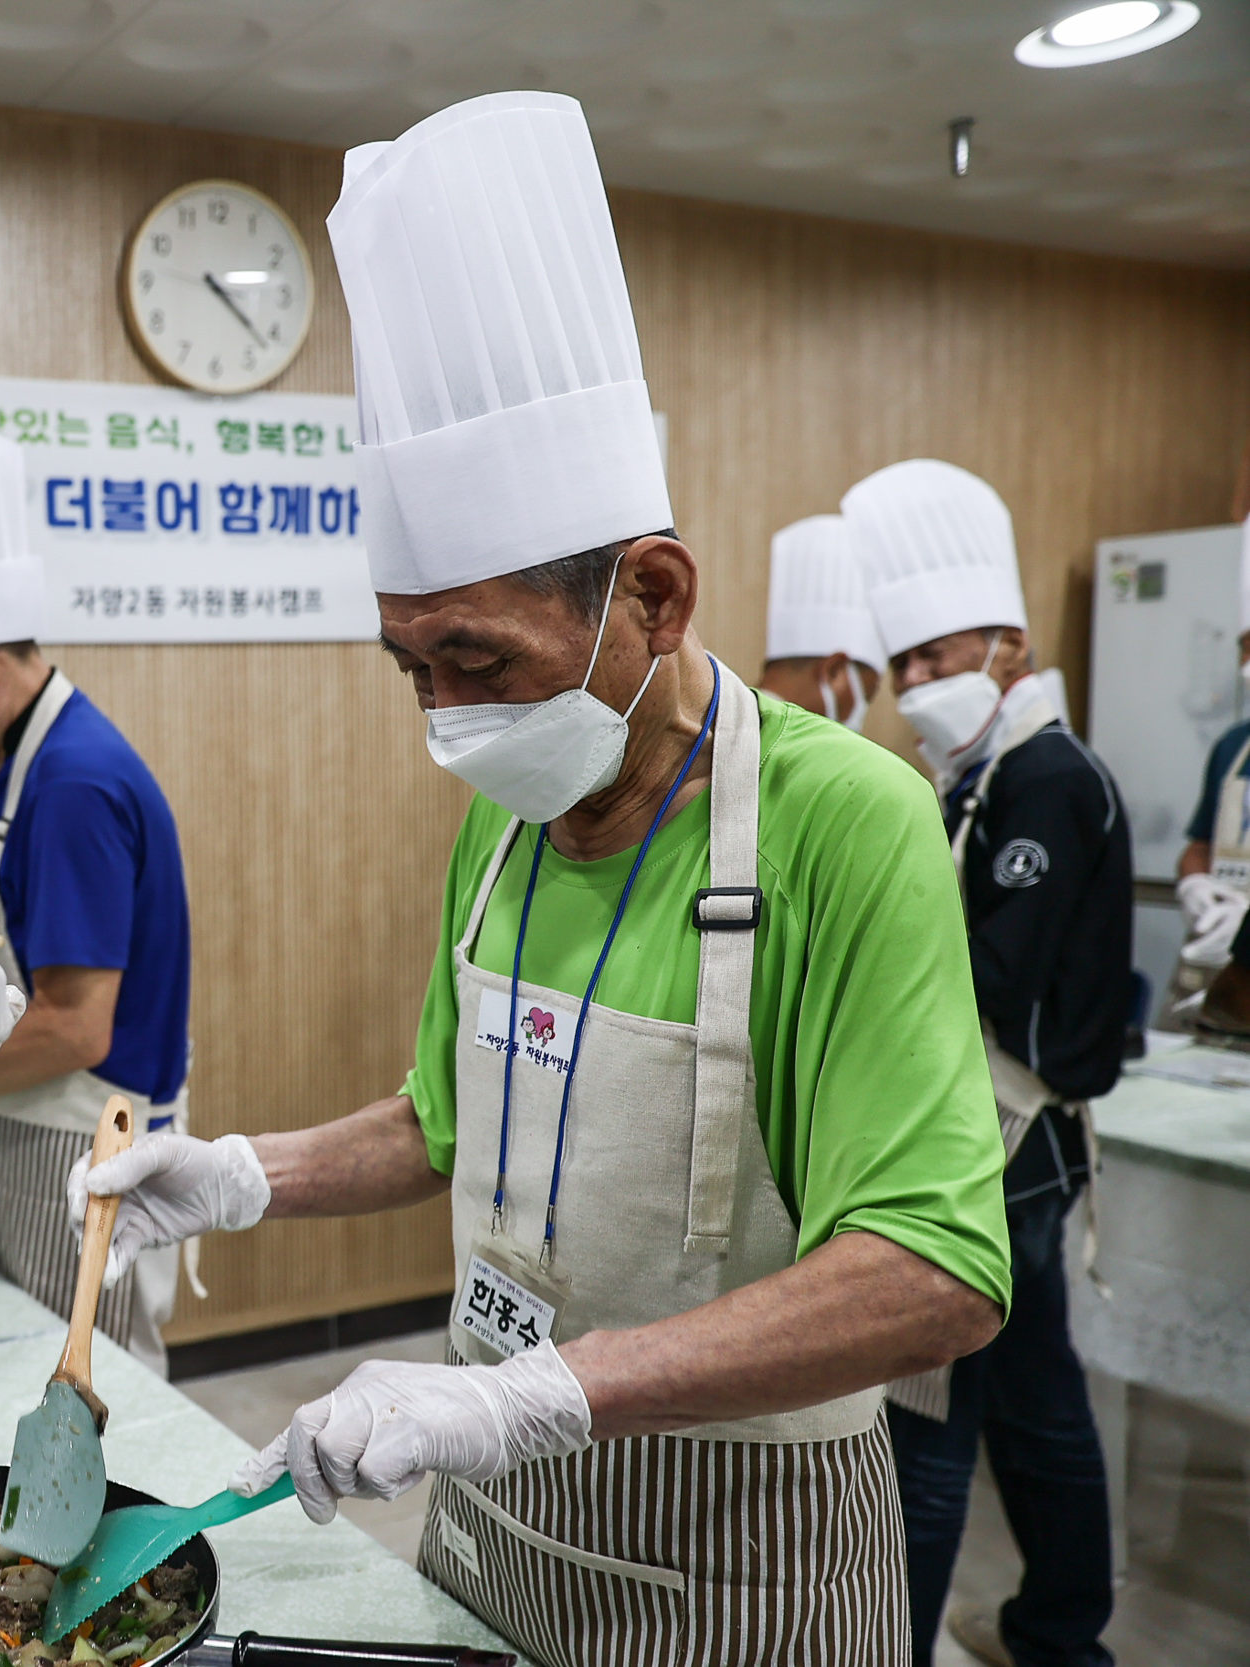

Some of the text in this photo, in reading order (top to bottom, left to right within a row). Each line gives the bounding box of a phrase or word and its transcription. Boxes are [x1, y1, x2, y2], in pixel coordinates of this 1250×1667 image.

[178, 205, 197, 230] 11
[207, 200, 230, 225] 12
[152, 232, 172, 258] 10
[268, 243, 284, 270] 2
[149, 308, 165, 335] 8
[178, 340, 192, 365] 7
[207, 355, 223, 379] 6
[107, 412, 197, 454] 음식,
[216, 420, 324, 458] 행복한
[45, 477, 199, 532] 더불어
[72, 585, 324, 618] 자양2동 자원봉사캠프
[486, 1033, 520, 1057] 자양2동
[525, 1045, 571, 1074] 자원봉사캠프
[468, 1277, 541, 1349] 한홍수
